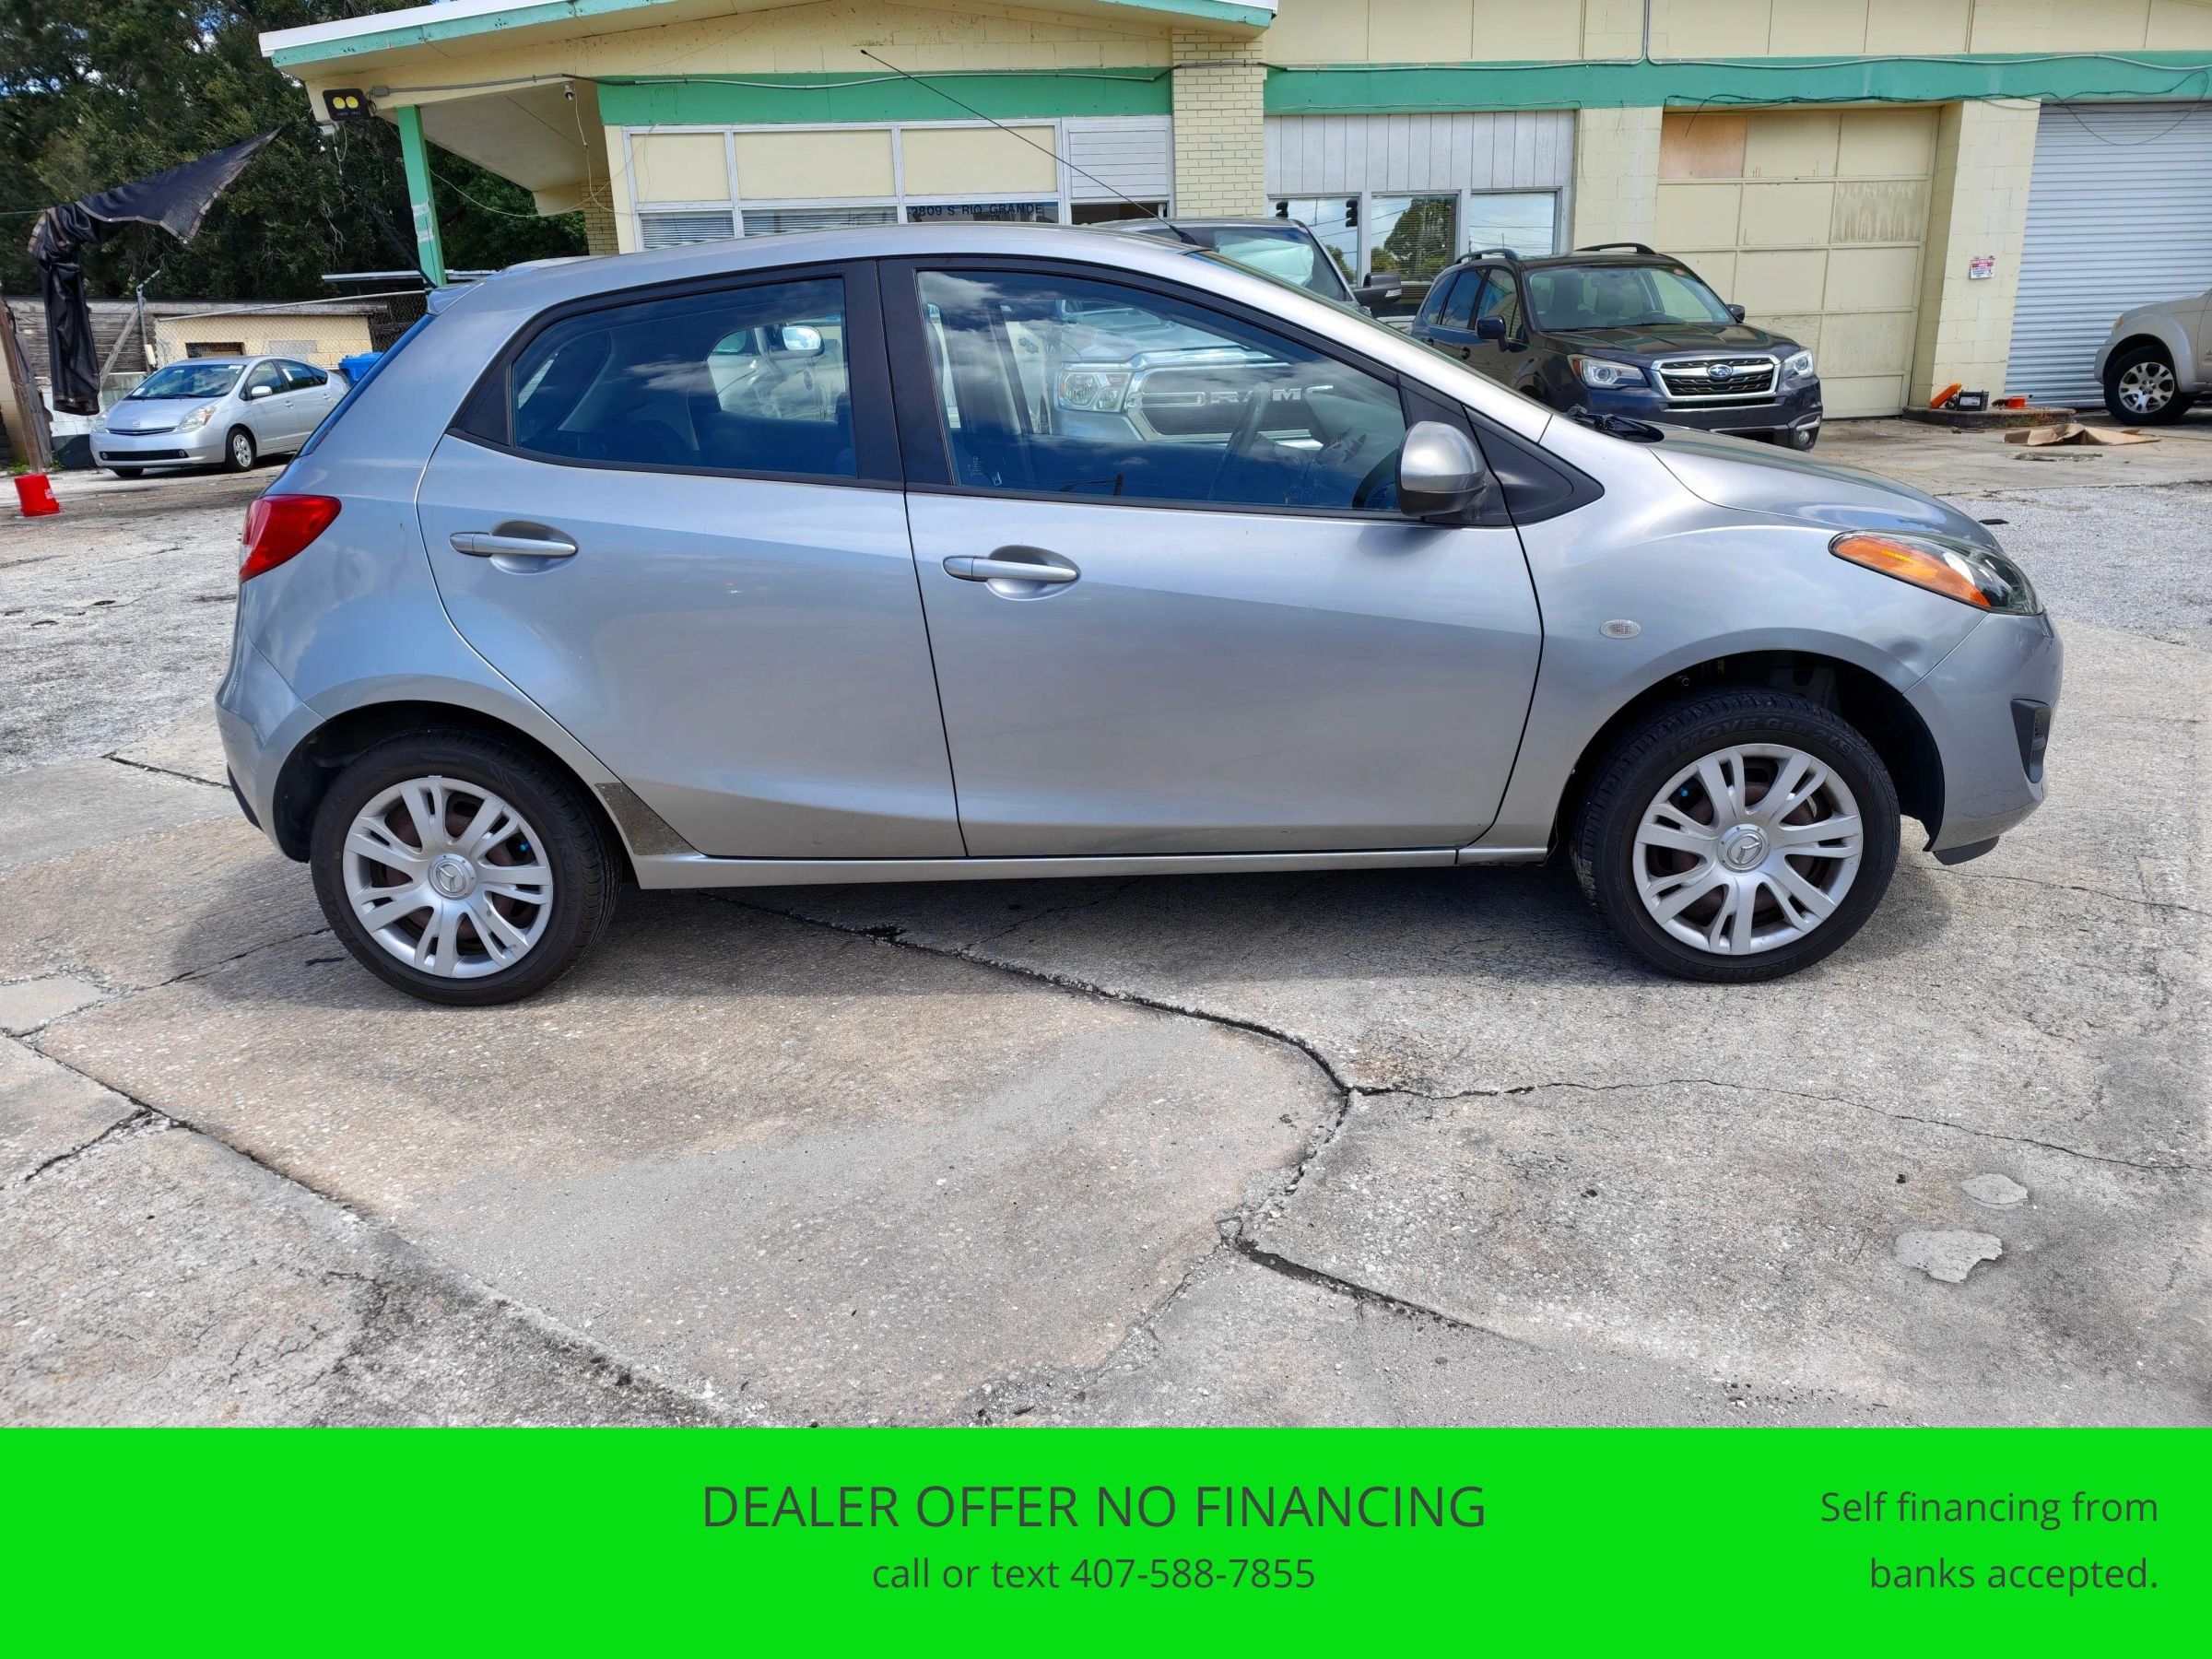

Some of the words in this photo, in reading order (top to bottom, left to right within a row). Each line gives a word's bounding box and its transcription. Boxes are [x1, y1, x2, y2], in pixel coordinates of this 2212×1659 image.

[912, 206, 942, 217] 2809
[962, 204, 982, 215] RIO
[989, 203, 1043, 214] GRANDE
[1830, 736, 1852, 754] AS
